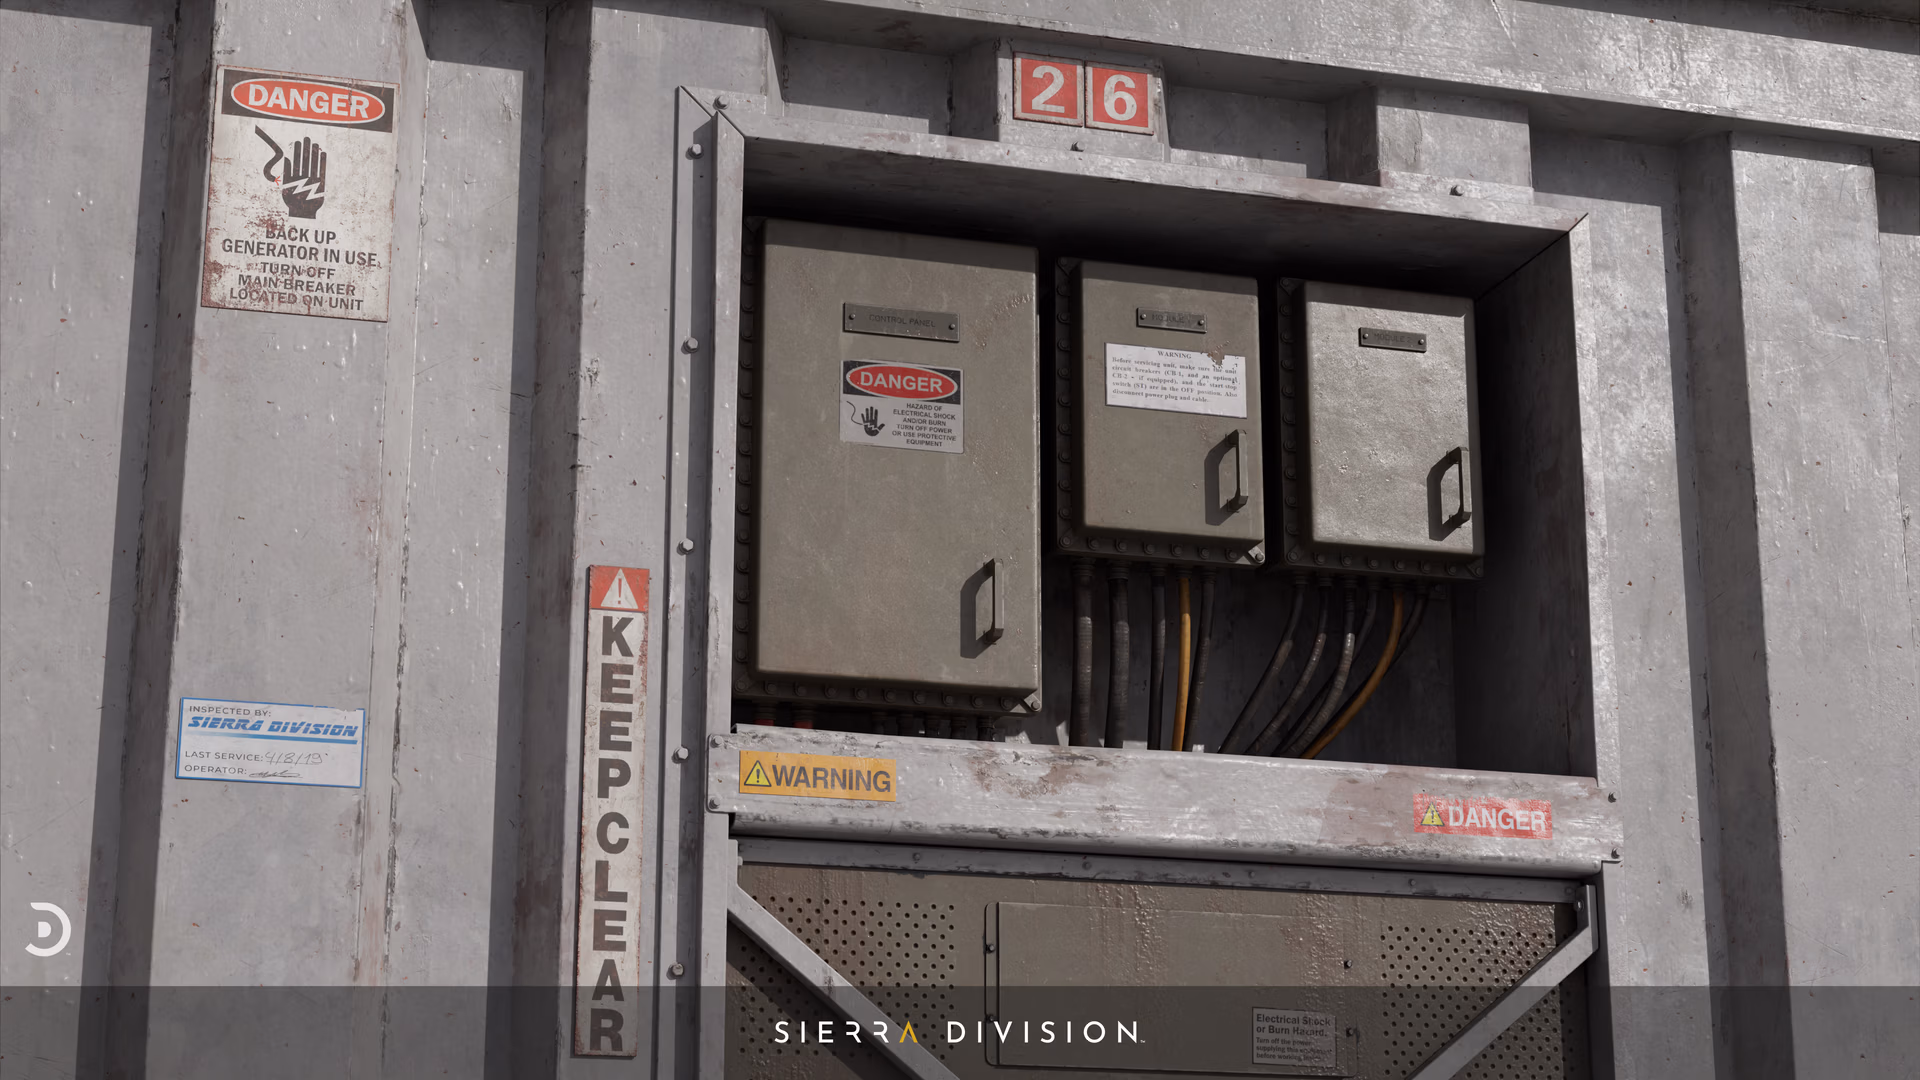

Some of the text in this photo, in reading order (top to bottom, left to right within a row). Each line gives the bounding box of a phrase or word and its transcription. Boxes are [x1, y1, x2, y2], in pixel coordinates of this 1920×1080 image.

[248, 84, 370, 118] DANGER
[265, 227, 336, 244] BACK UP
[222, 238, 318, 262] GENERATOR
[324, 248, 340, 263] IN
[261, 262, 336, 280] TURN OFF
[238, 274, 356, 296] MAIN BREAKER
[230, 287, 364, 311] LOCATED ON UNIT
[869, 314, 936, 328] CONTROL PANEL
[1157, 350, 1192, 359] WARNING
[860, 371, 942, 393] DANGER
[1213, 375, 1238, 383] optional
[1112, 388, 1144, 397] disconnect
[906, 403, 932, 411] HAZARD
[893, 409, 956, 420] ELECTRICAL SHOCK
[902, 417, 927, 425] AND/OR
[906, 439, 943, 447] EQUIPMENT
[917, 433, 957, 442] PROTECTIVE
[189, 705, 271, 717] INSPECTED BY:
[188, 716, 359, 737] SIERRA DIVISION
[185, 751, 264, 762] LAST SERVICE:
[184, 764, 247, 775] OPERATOR:
[772, 764, 891, 792] WARNING
[1448, 806, 1546, 831] DANGER
[588, 615, 634, 1052] KEEP CLEAR
[1256, 1013, 1300, 1024] Electrical
[1268, 1025, 1290, 1034] Burn
